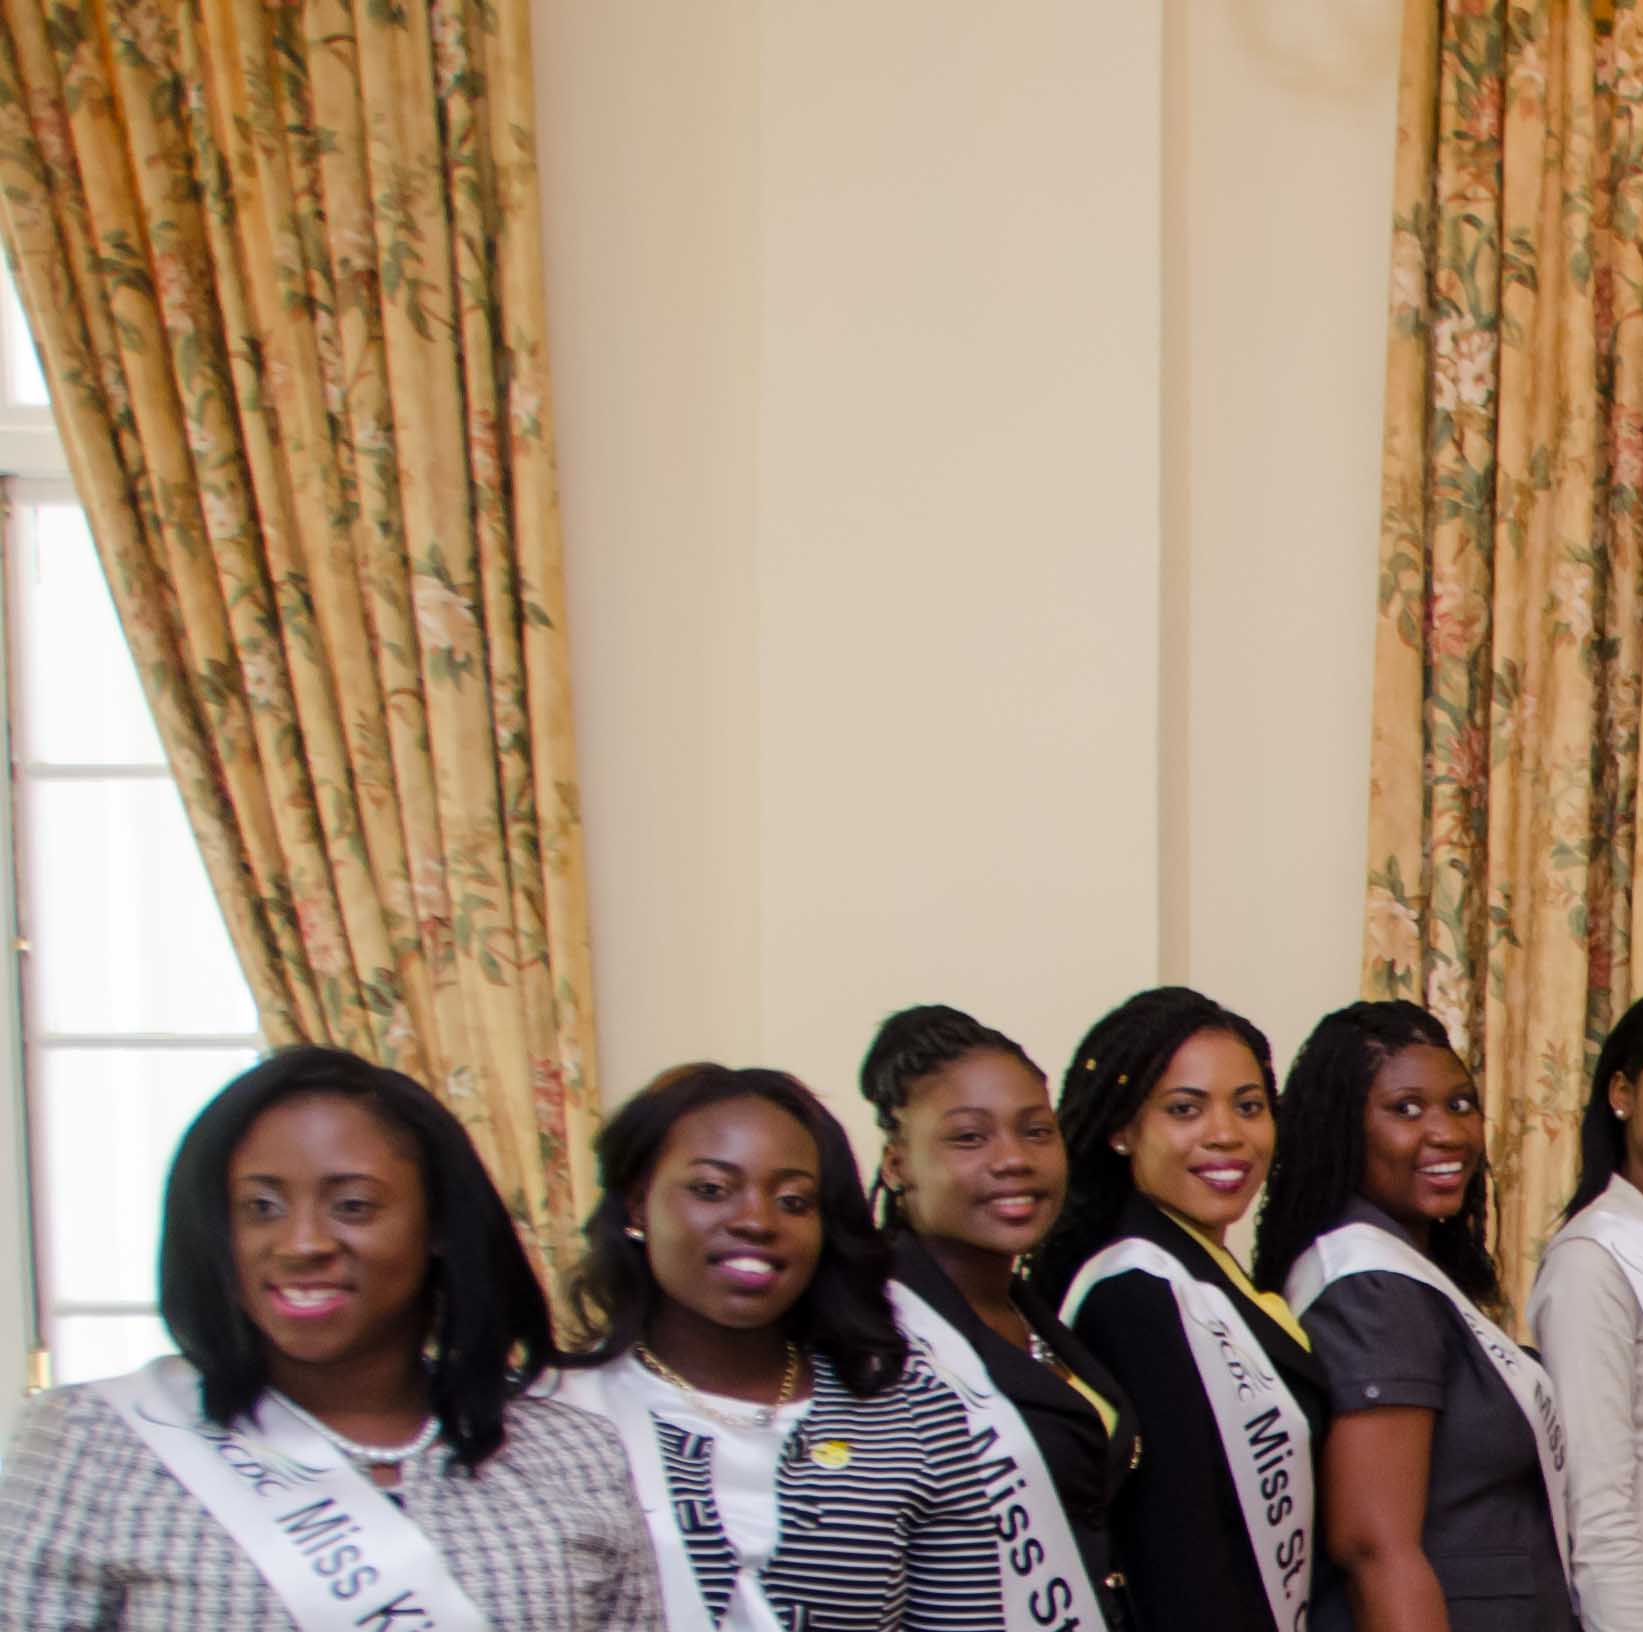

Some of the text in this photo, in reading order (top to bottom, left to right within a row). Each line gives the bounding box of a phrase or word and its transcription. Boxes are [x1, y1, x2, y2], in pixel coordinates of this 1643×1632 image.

[275, 1498, 380, 1601] Miss
[1243, 1405, 1305, 1600] Miss St.
